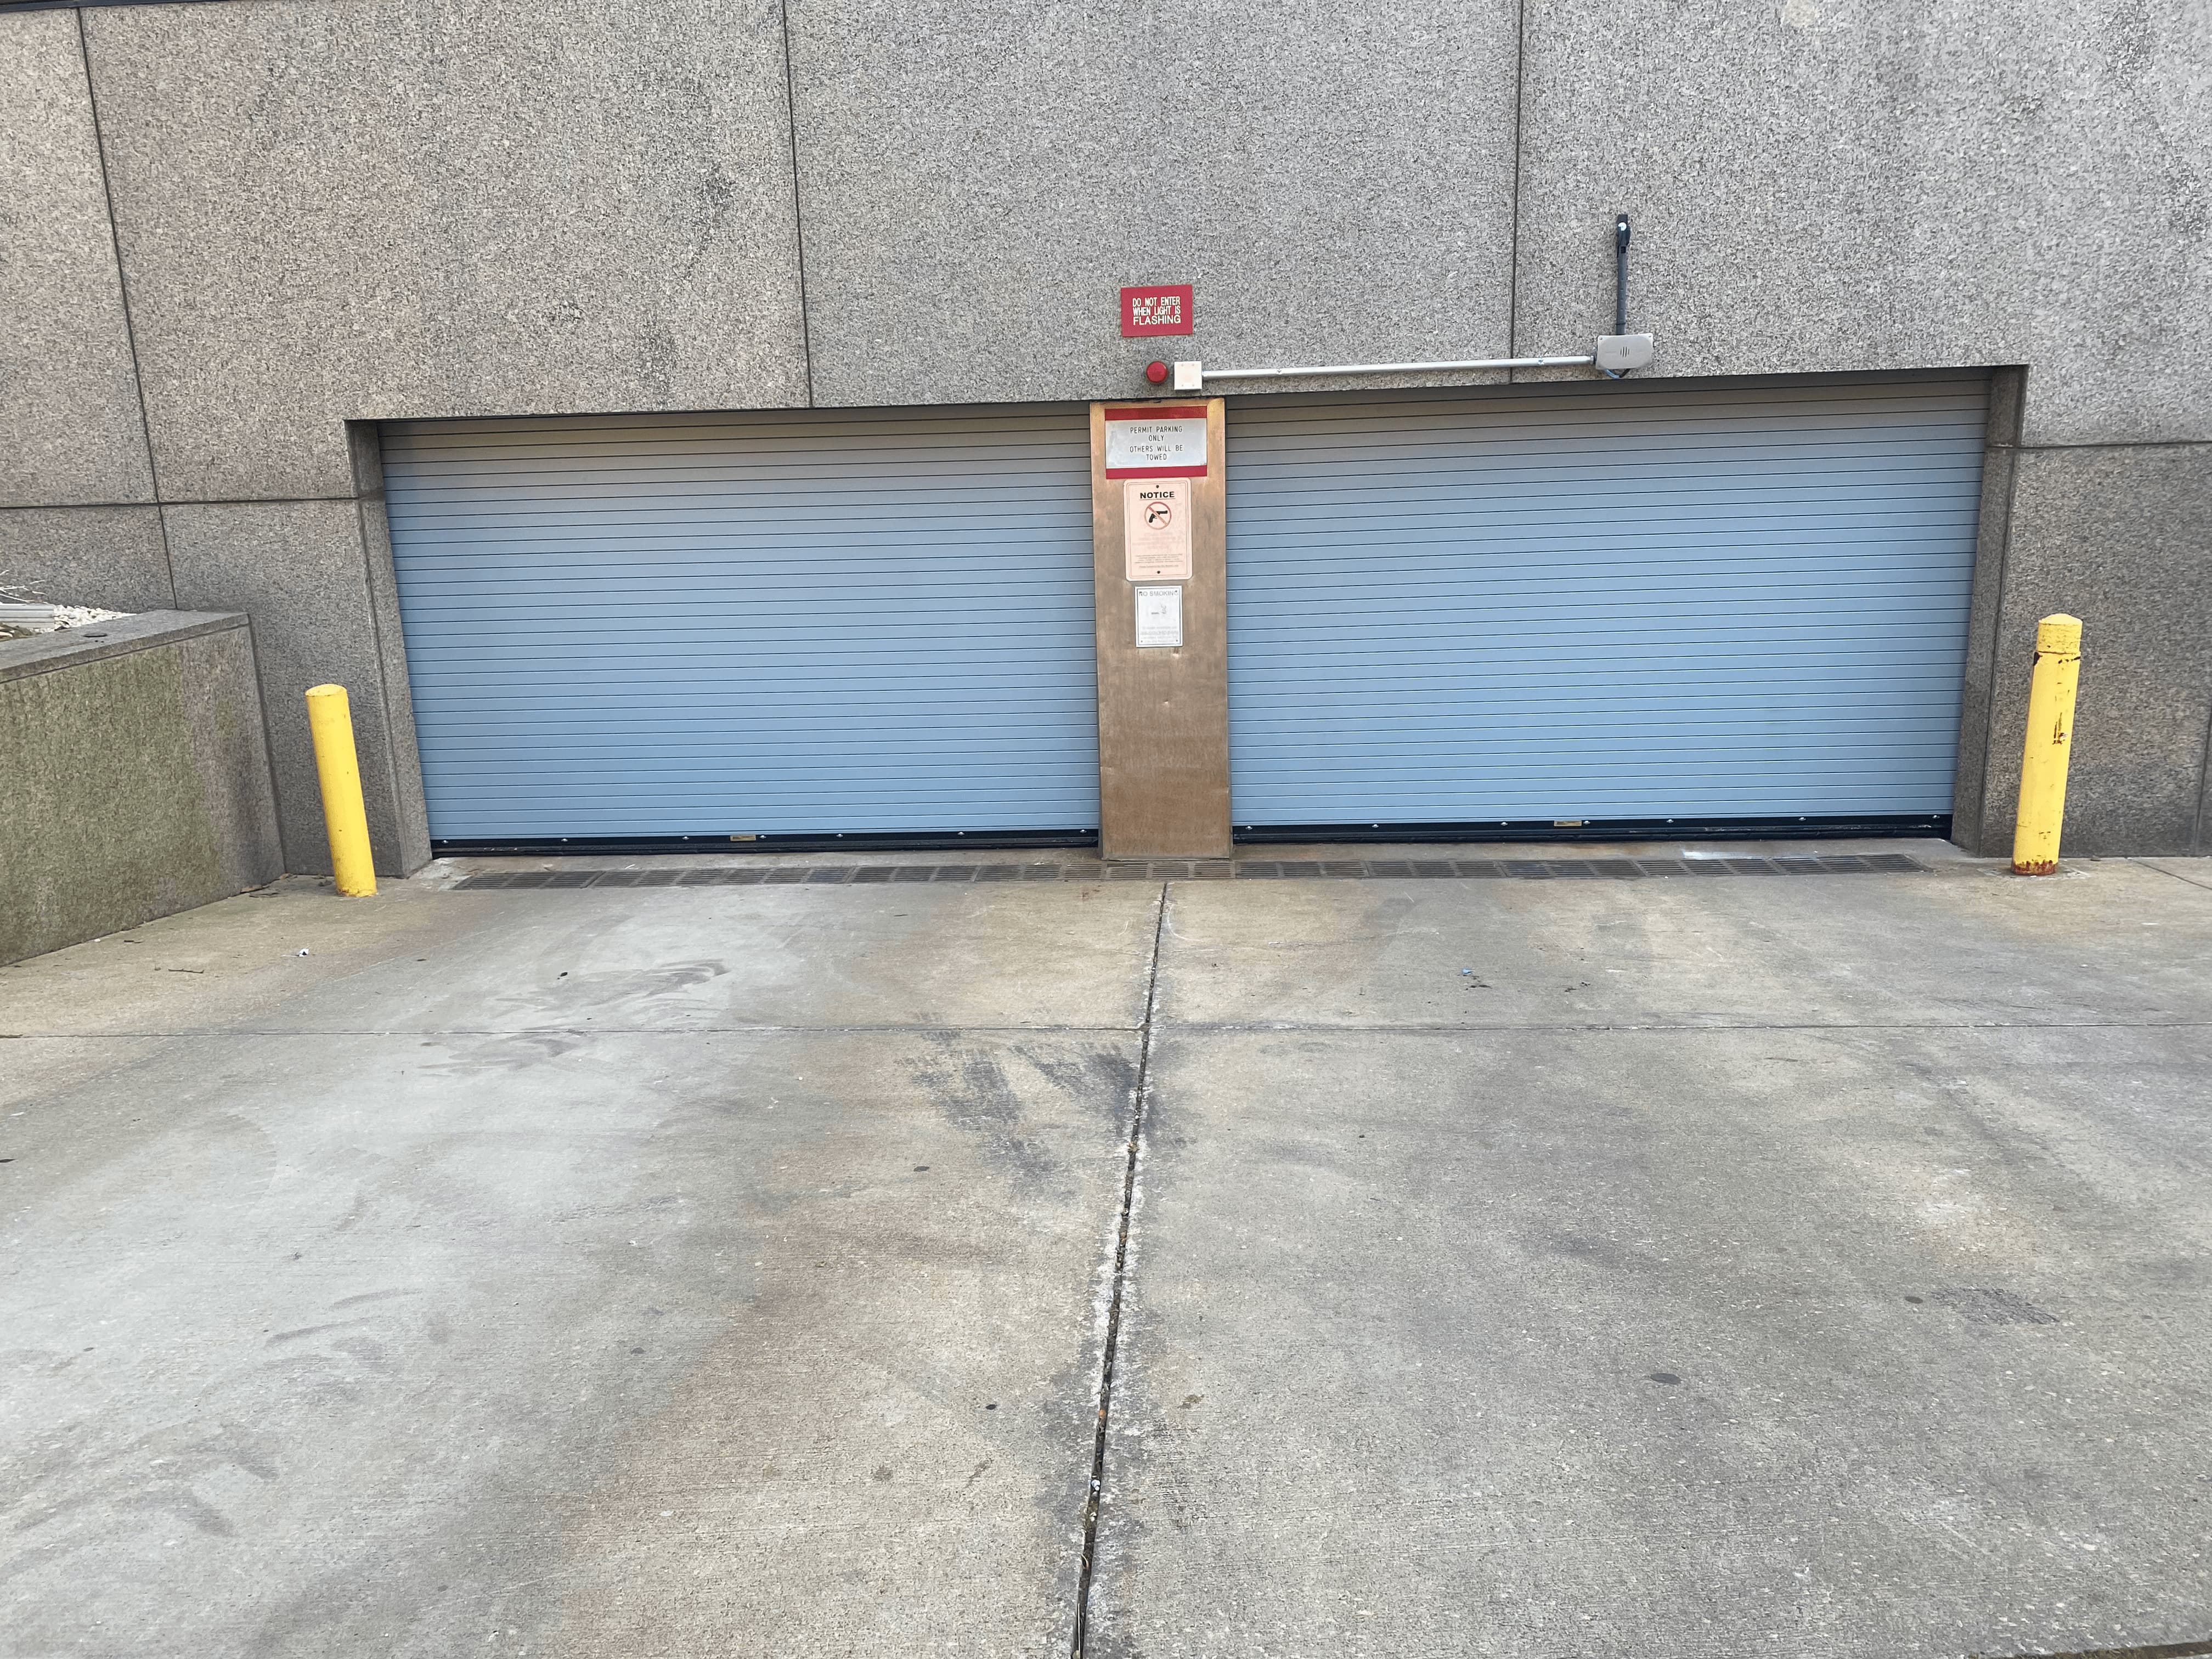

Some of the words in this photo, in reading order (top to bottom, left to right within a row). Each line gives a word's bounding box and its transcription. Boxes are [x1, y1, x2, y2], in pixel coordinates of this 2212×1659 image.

[1132, 298, 1142, 307] DO
[1144, 297, 1158, 306] NOT
[1160, 296, 1181, 306] ENTER
[1133, 307, 1151, 316] WHEN
[1154, 306, 1171, 315] LIGHT
[1175, 305, 1181, 314] IS
[1133, 314, 1181, 325] FLASHING
